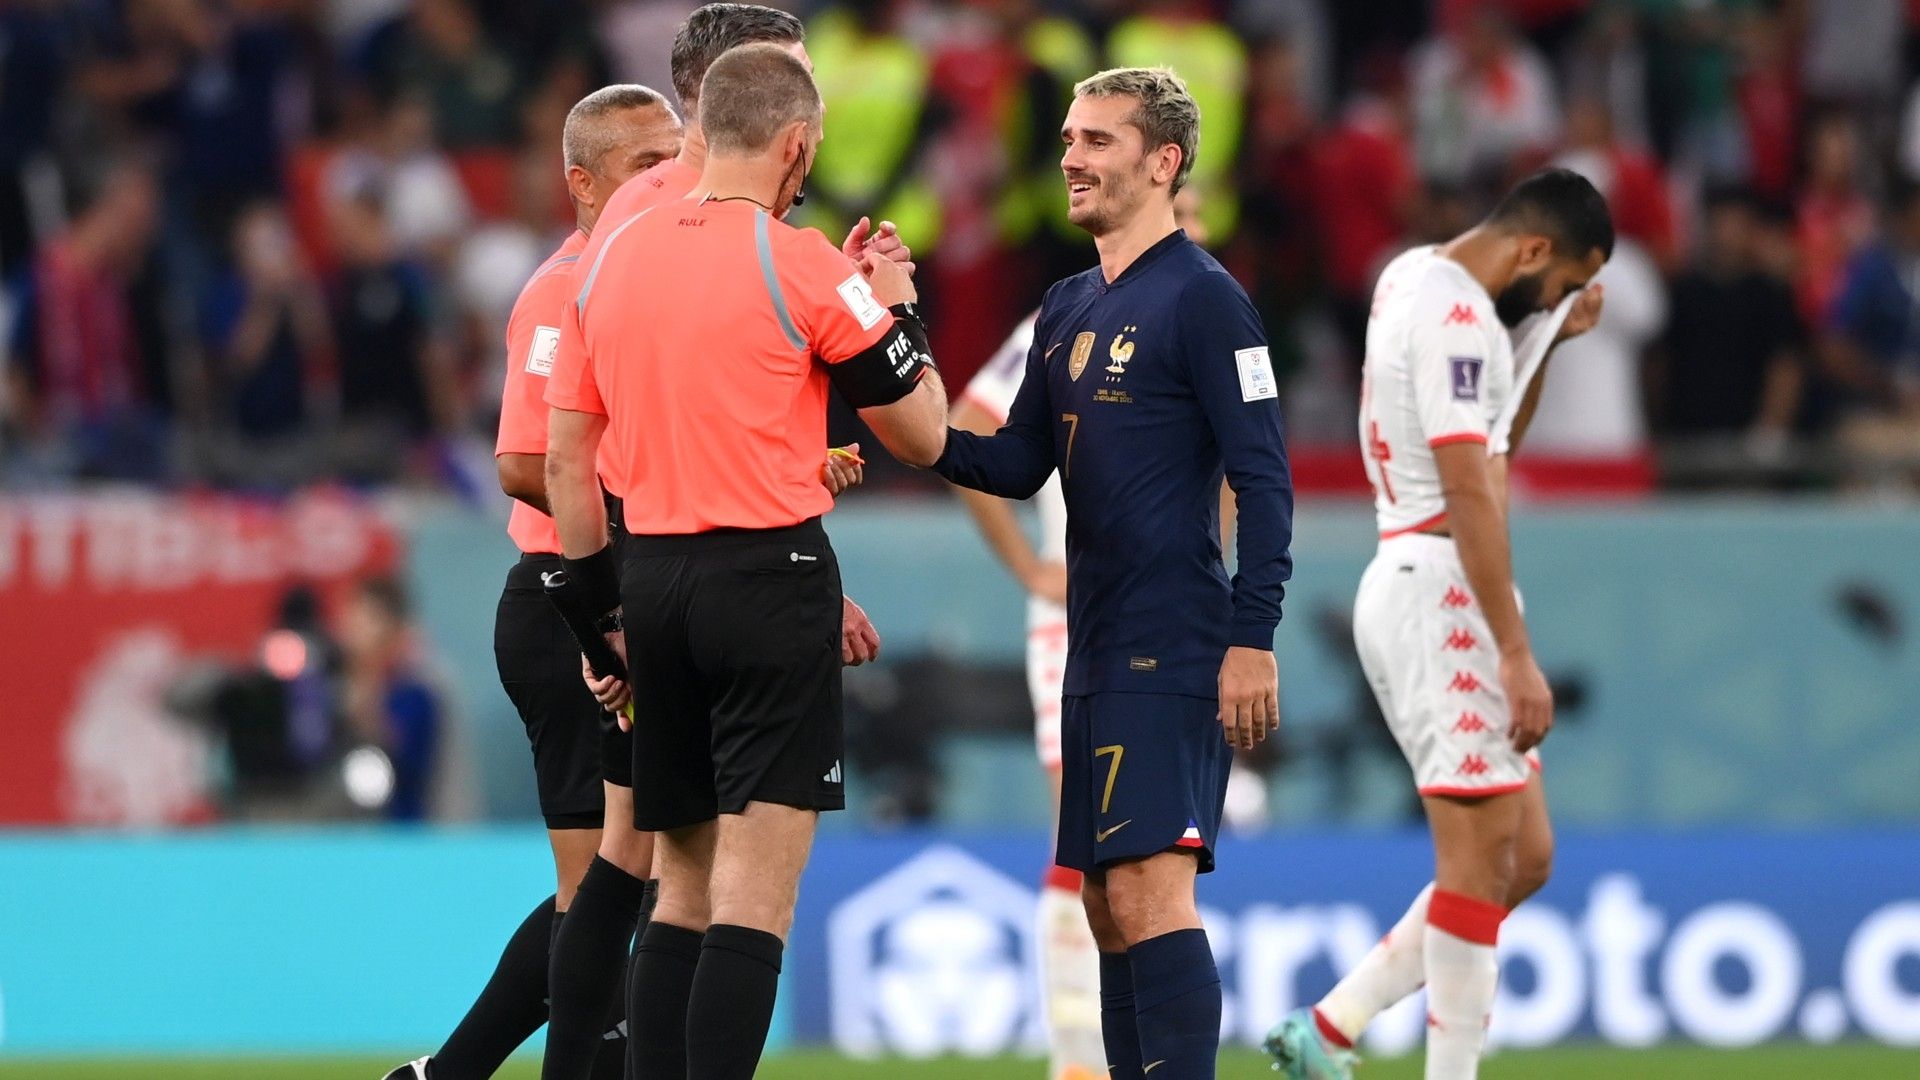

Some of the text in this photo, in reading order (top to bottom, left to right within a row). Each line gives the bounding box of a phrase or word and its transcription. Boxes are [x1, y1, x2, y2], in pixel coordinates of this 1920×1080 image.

[678, 218, 706, 227] RULE
[896, 356, 915, 379] TEAM
[1062, 413, 1079, 480] 7
[1095, 744, 1125, 814] 7
